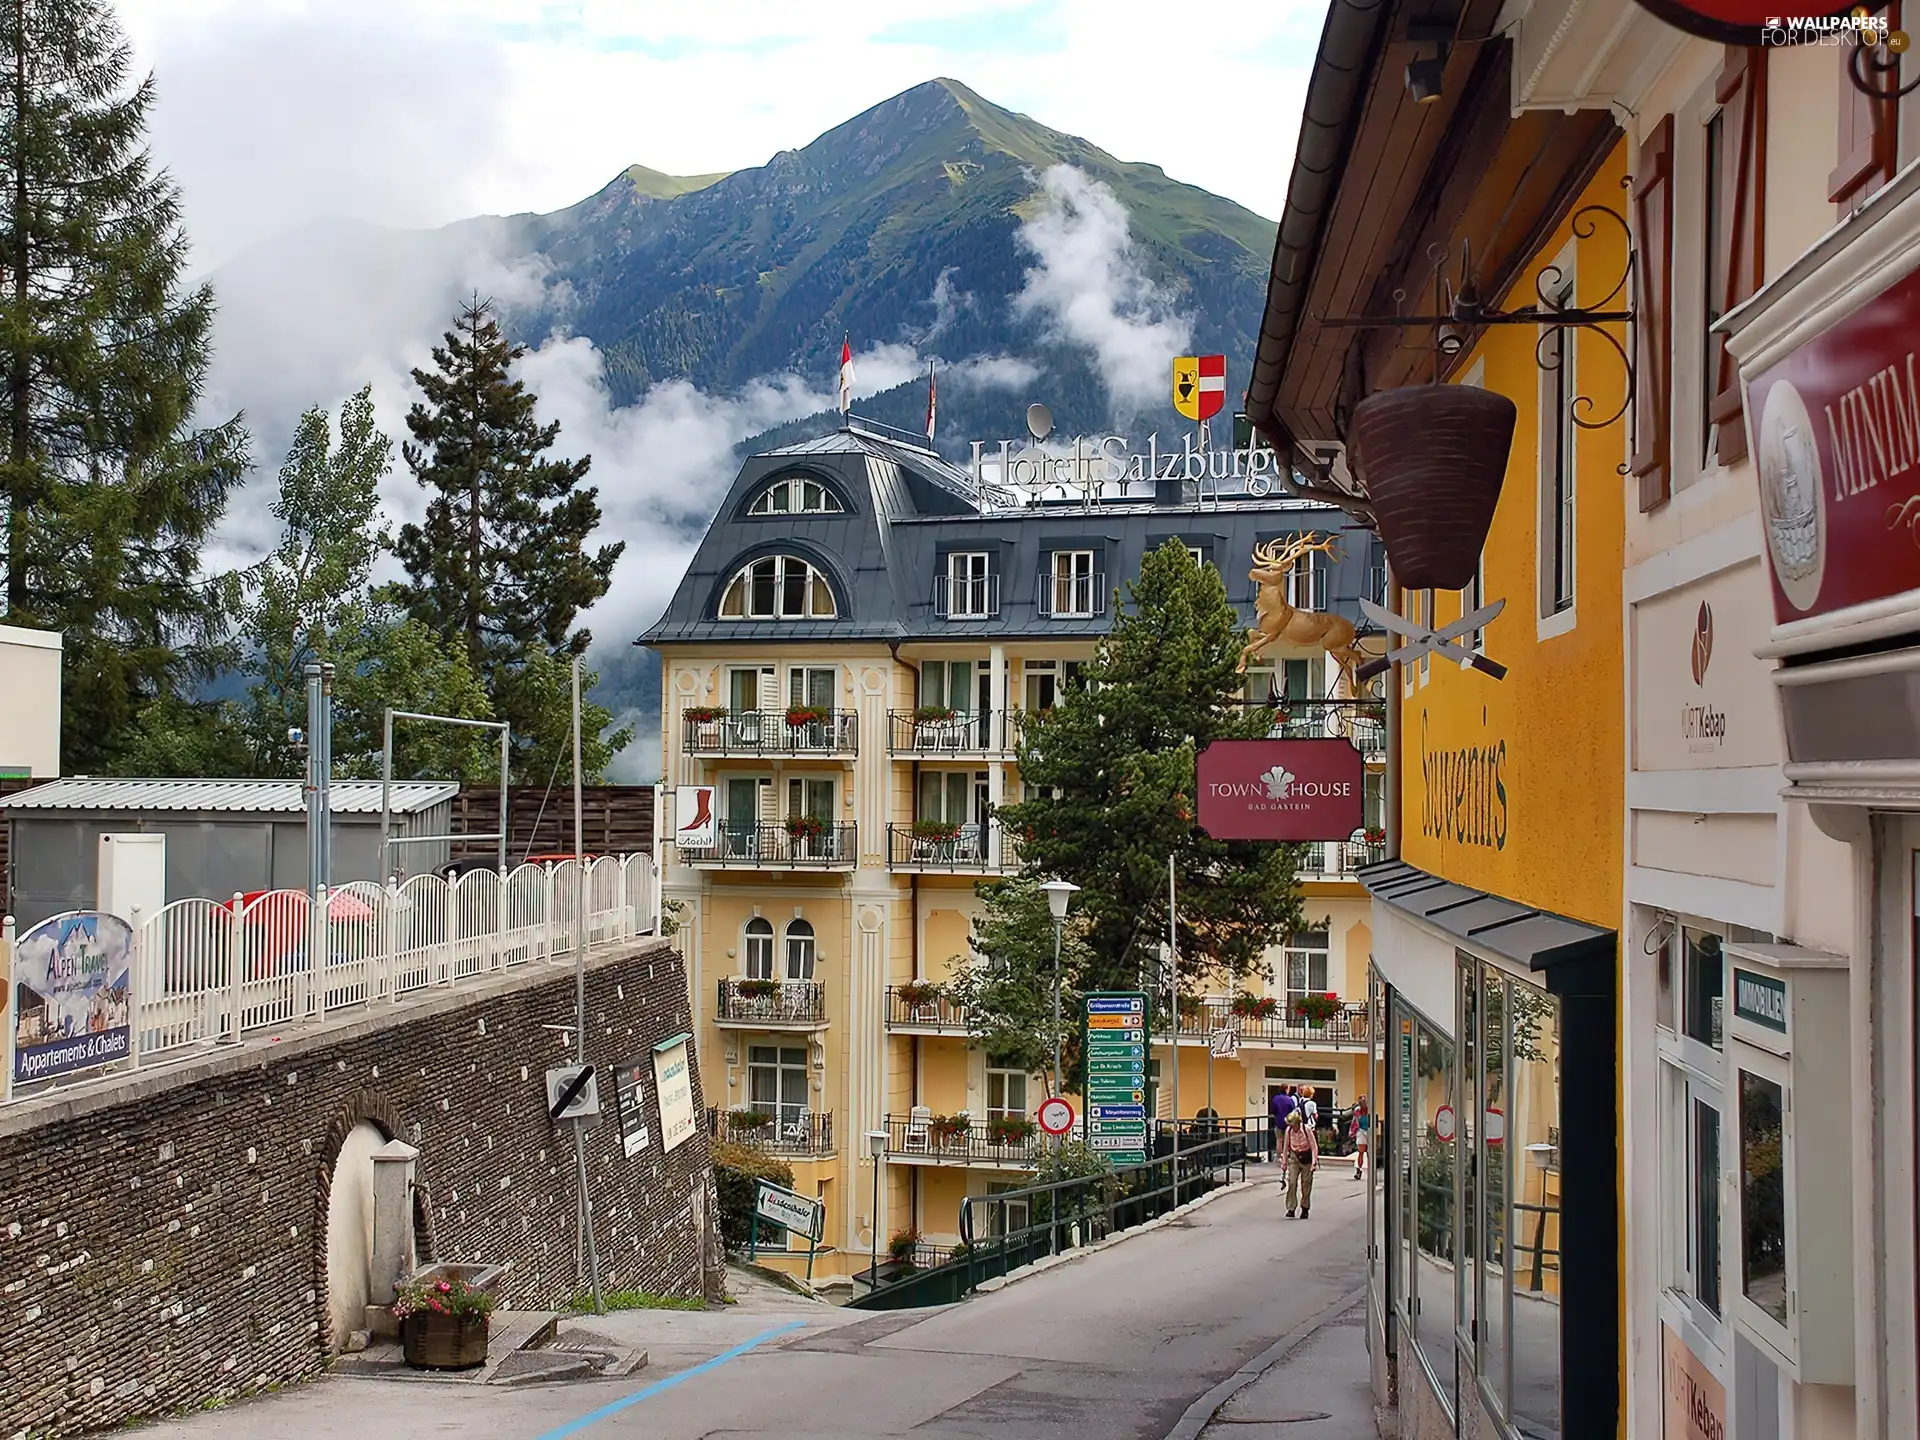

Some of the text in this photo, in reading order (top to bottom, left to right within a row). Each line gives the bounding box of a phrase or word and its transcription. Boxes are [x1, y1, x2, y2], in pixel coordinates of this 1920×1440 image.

[969, 431, 1280, 497] Hotel Salzburg
[1209, 782, 1350, 797] TOWN HOUSE
[1421, 705, 1507, 851] Souvenirs
[20, 1033, 126, 1077] Appartements & Chalets
